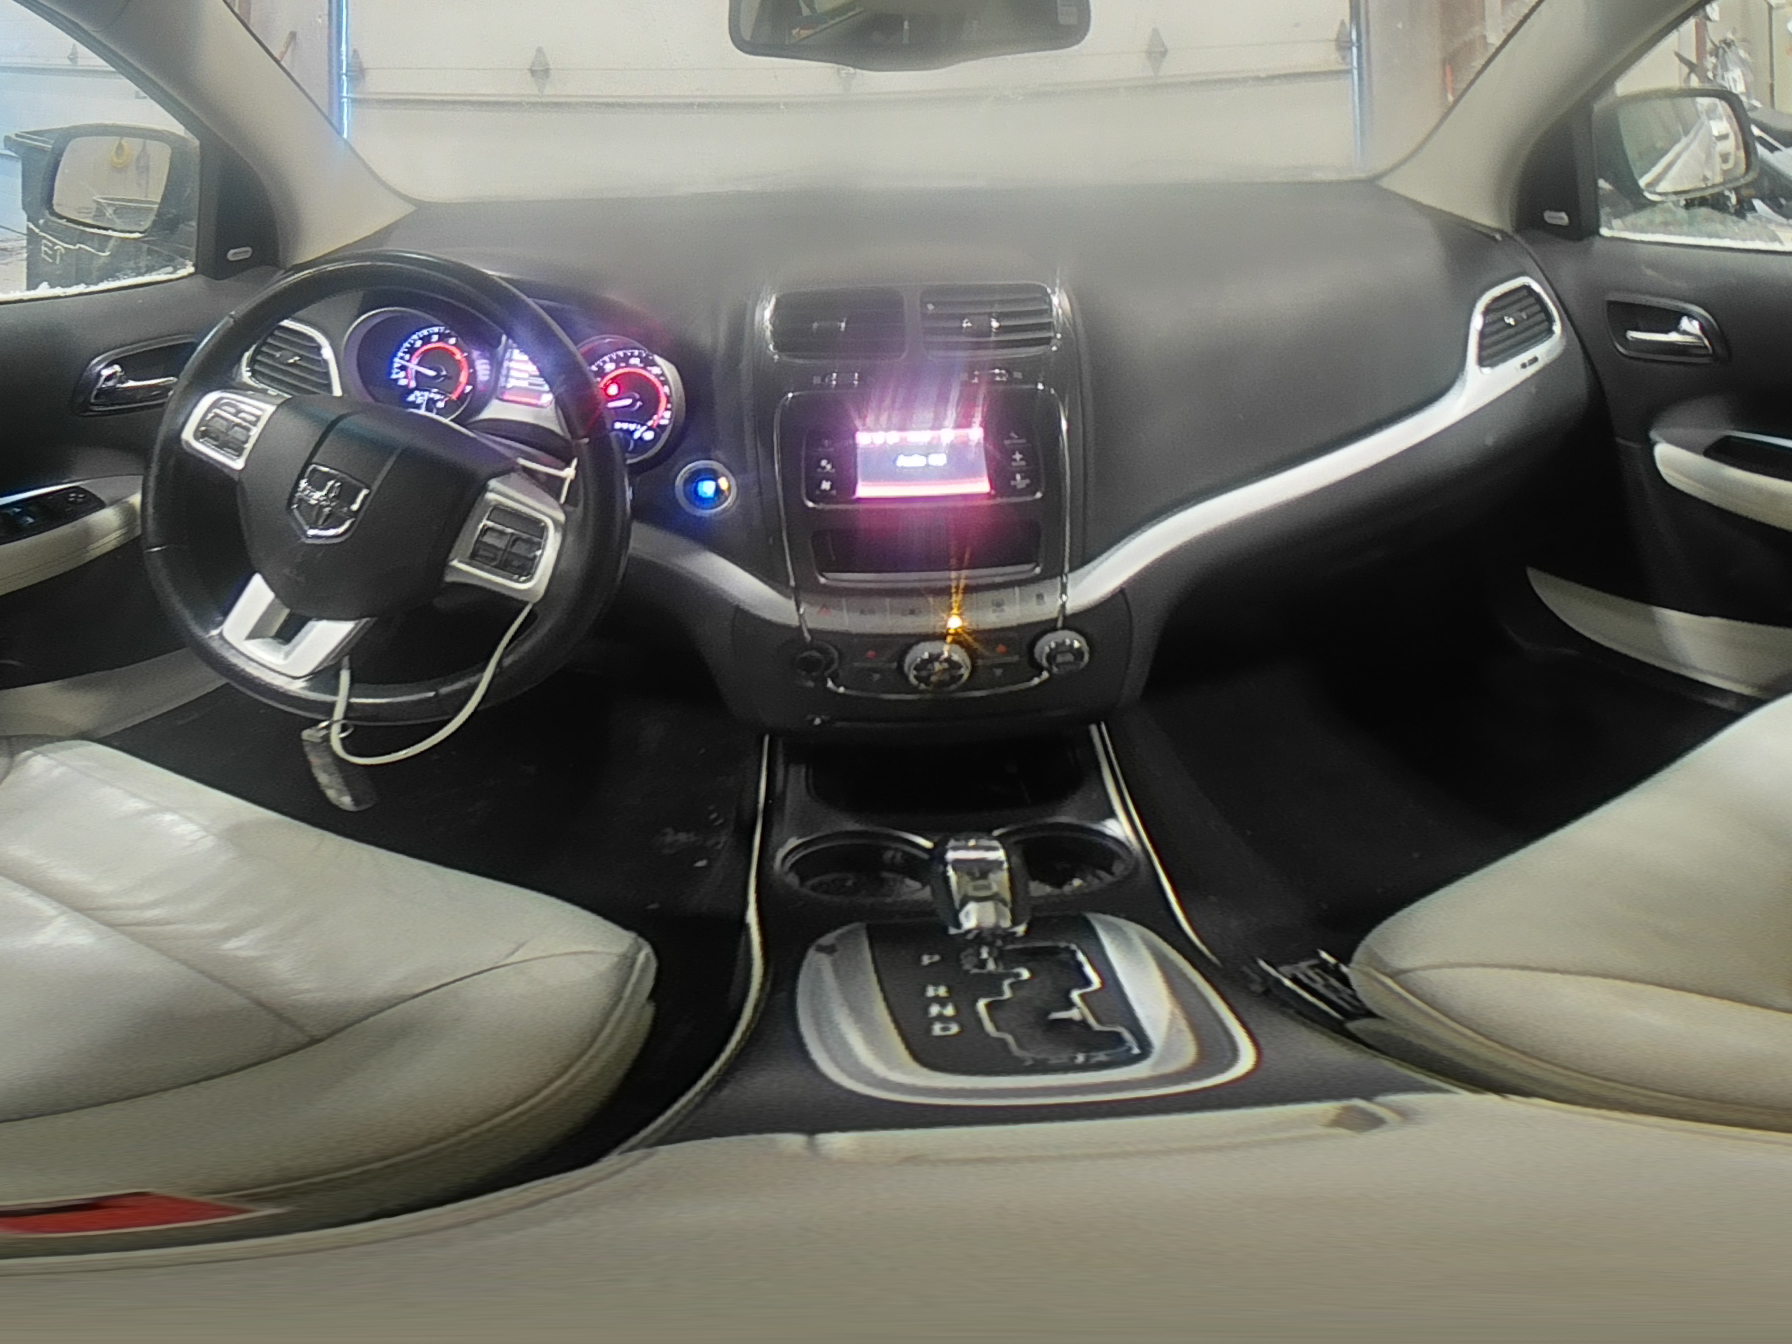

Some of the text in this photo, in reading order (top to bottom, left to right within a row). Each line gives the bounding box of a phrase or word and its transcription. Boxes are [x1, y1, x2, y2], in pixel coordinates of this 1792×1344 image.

[921, 954, 942, 967] P
[925, 984, 950, 997] R
[928, 1002, 956, 1018] N
[931, 1022, 961, 1036] D
